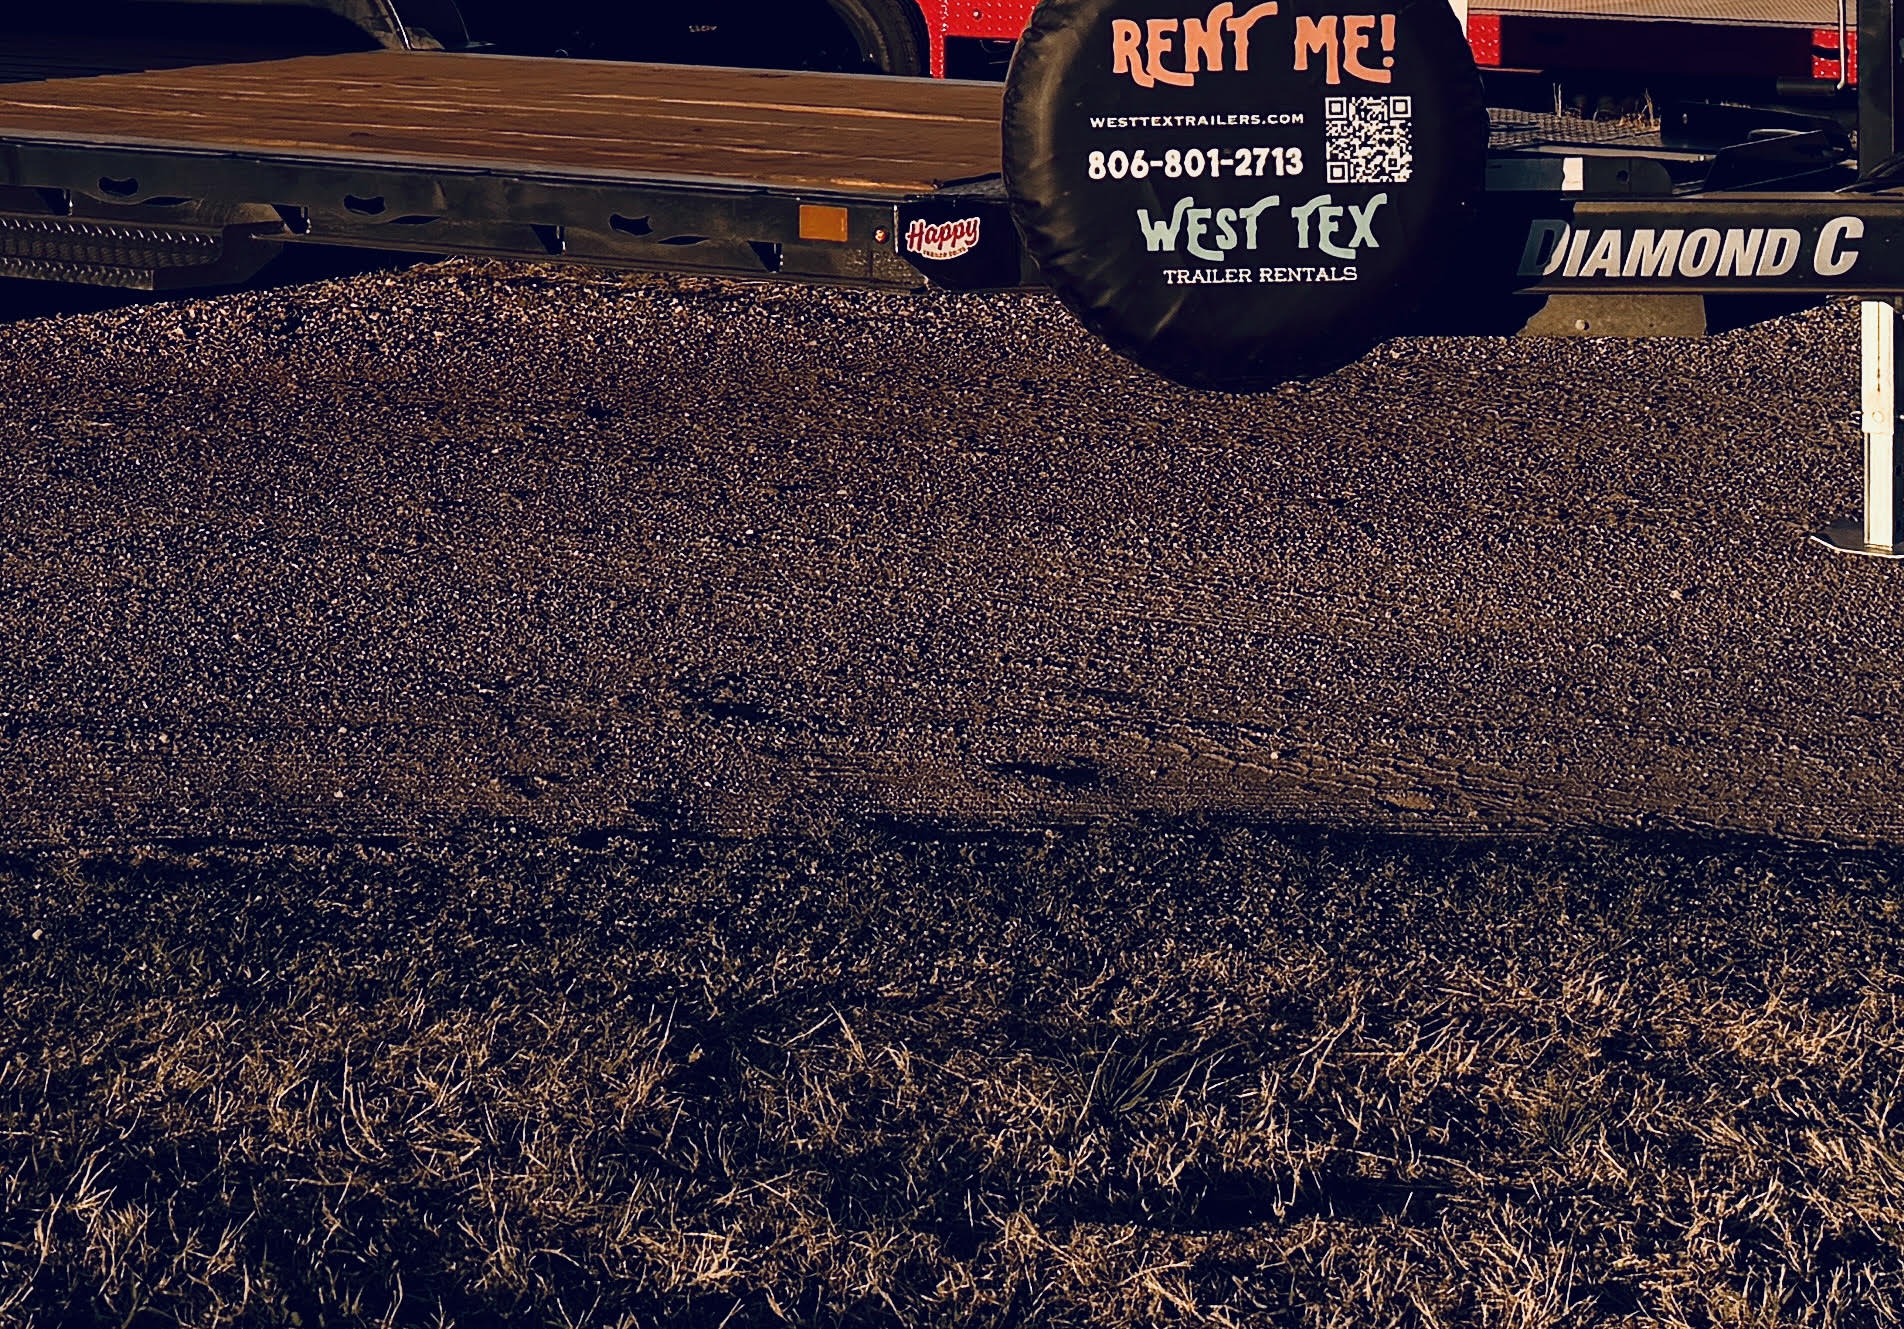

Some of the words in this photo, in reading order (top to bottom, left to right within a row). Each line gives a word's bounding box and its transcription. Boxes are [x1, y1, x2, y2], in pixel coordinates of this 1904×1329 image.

[1111, 0, 1279, 89] RENT
[1293, 13, 1396, 85] ME!
[1089, 113, 1305, 129] WESTTEXTRAILERS.COM
[1088, 146, 1304, 180] 806-801-2713
[907, 219, 978, 251] Happy
[1136, 194, 1280, 262] WEST
[1290, 192, 1388, 260] TEX
[1517, 219, 1802, 277] DIAMOND
[1813, 216, 1865, 276] C
[1162, 268, 1253, 285] TRAILER
[1258, 266, 1358, 283] RENTALS
